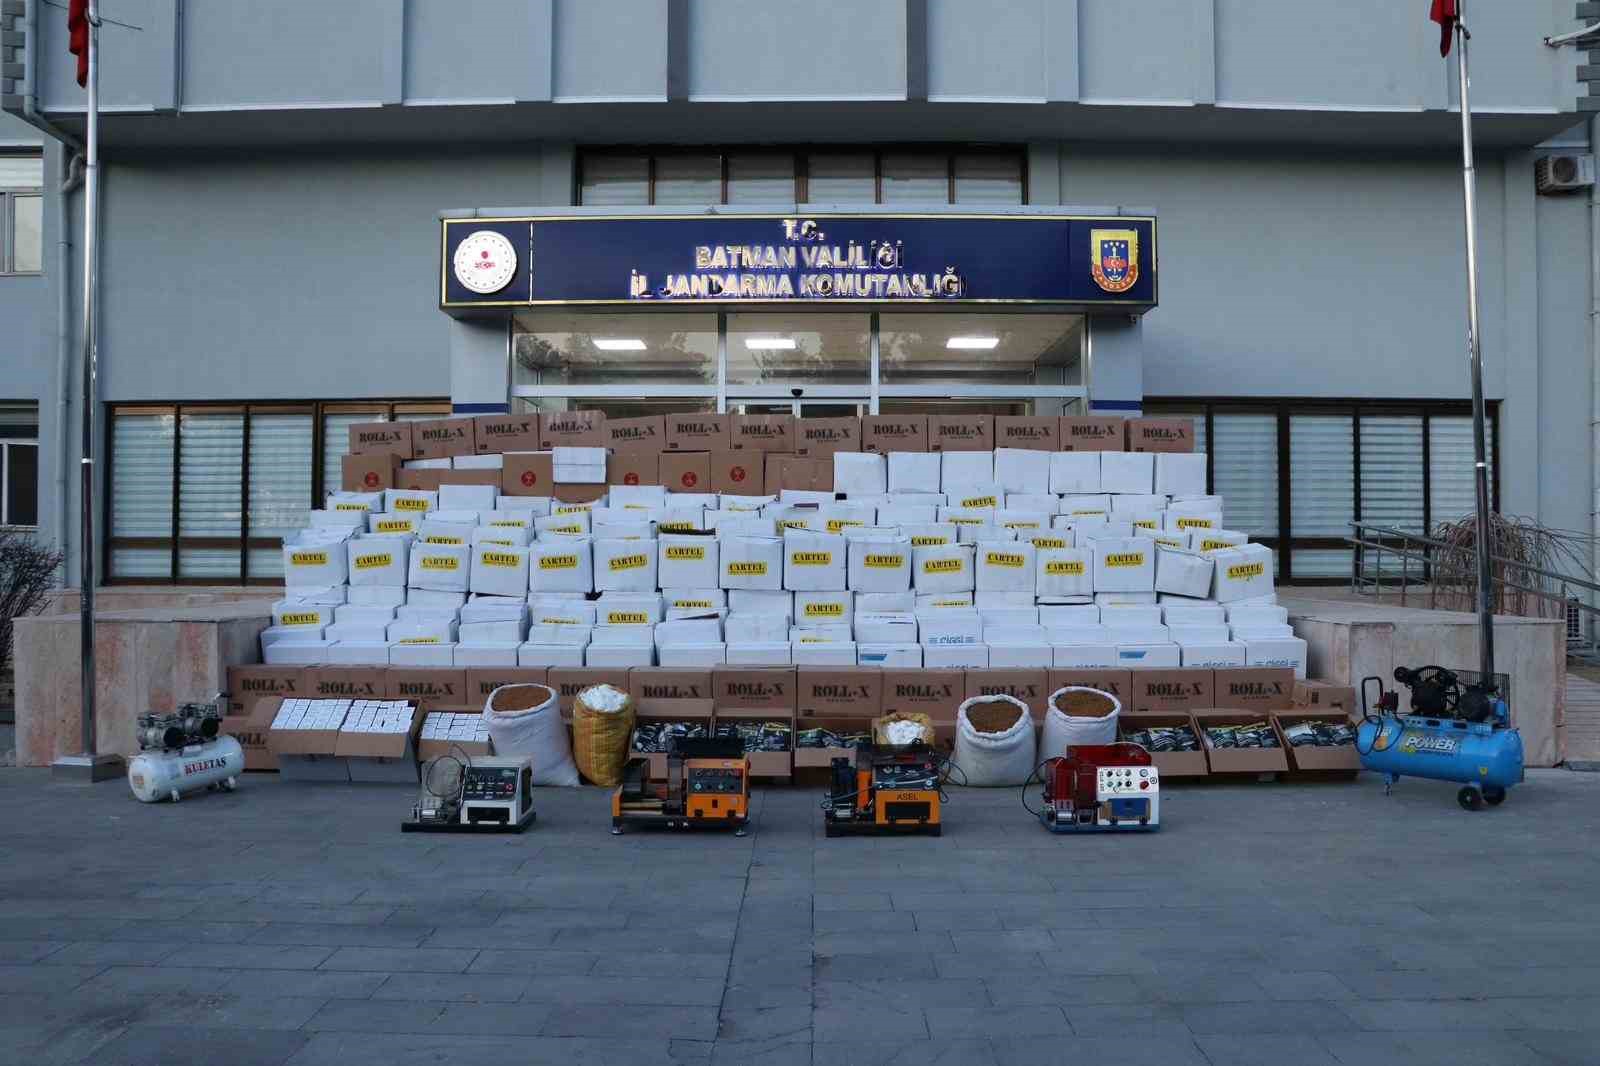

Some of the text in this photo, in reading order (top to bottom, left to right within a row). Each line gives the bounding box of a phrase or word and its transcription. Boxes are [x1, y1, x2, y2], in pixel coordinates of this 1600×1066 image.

[782, 219, 825, 241] T.C.
[695, 239, 904, 269] BATMAN VALİLİĞİ
[630, 265, 967, 297] İL JANDARMA KOMUTANLIĞI
[394, 498, 428, 508] CARTEL
[962, 497, 993, 508] CARTEL
[378, 520, 411, 530] CARTEL
[1178, 520, 1210, 528] CARTEL
[911, 537, 945, 545] CARTEL
[1032, 538, 1065, 547] CARTEL
[667, 547, 703, 556] CARTEL
[291, 553, 327, 562] CARTEL
[356, 554, 391, 565] CARTEL
[422, 558, 457, 566] CARTEL
[483, 553, 519, 564] CARTEL
[541, 556, 576, 566] CARTEL
[610, 556, 646, 567] CARTEL
[793, 552, 829, 562] CARTEL
[865, 554, 901, 564] CARTEL
[987, 553, 1023, 563] CARTEL
[1107, 554, 1144, 563] CARTEL
[730, 563, 766, 572] CARTEL
[925, 559, 961, 569] CARTEL
[1047, 563, 1083, 572] CARTEL
[1230, 565, 1263, 575] CARTEL
[805, 604, 842, 613] CARTEL
[283, 614, 317, 624] CARTEL
[609, 614, 645, 623] CARTEL
[242, 679, 296, 692] ROLL-X
[320, 681, 375, 695] ROLL-X
[399, 682, 455, 695] ROLL-X
[726, 682, 785, 696] ROLL-X
[896, 683, 953, 697] ROLL-X
[1145, 681, 1203, 696] ROLL-X
[1230, 682, 1284, 695] ROLL-X
[643, 684, 702, 698] ROLL-X
[813, 685, 870, 698] ROLL-X
[1406, 736, 1456, 751] POWER
[896, 791, 919, 801] ASEL
